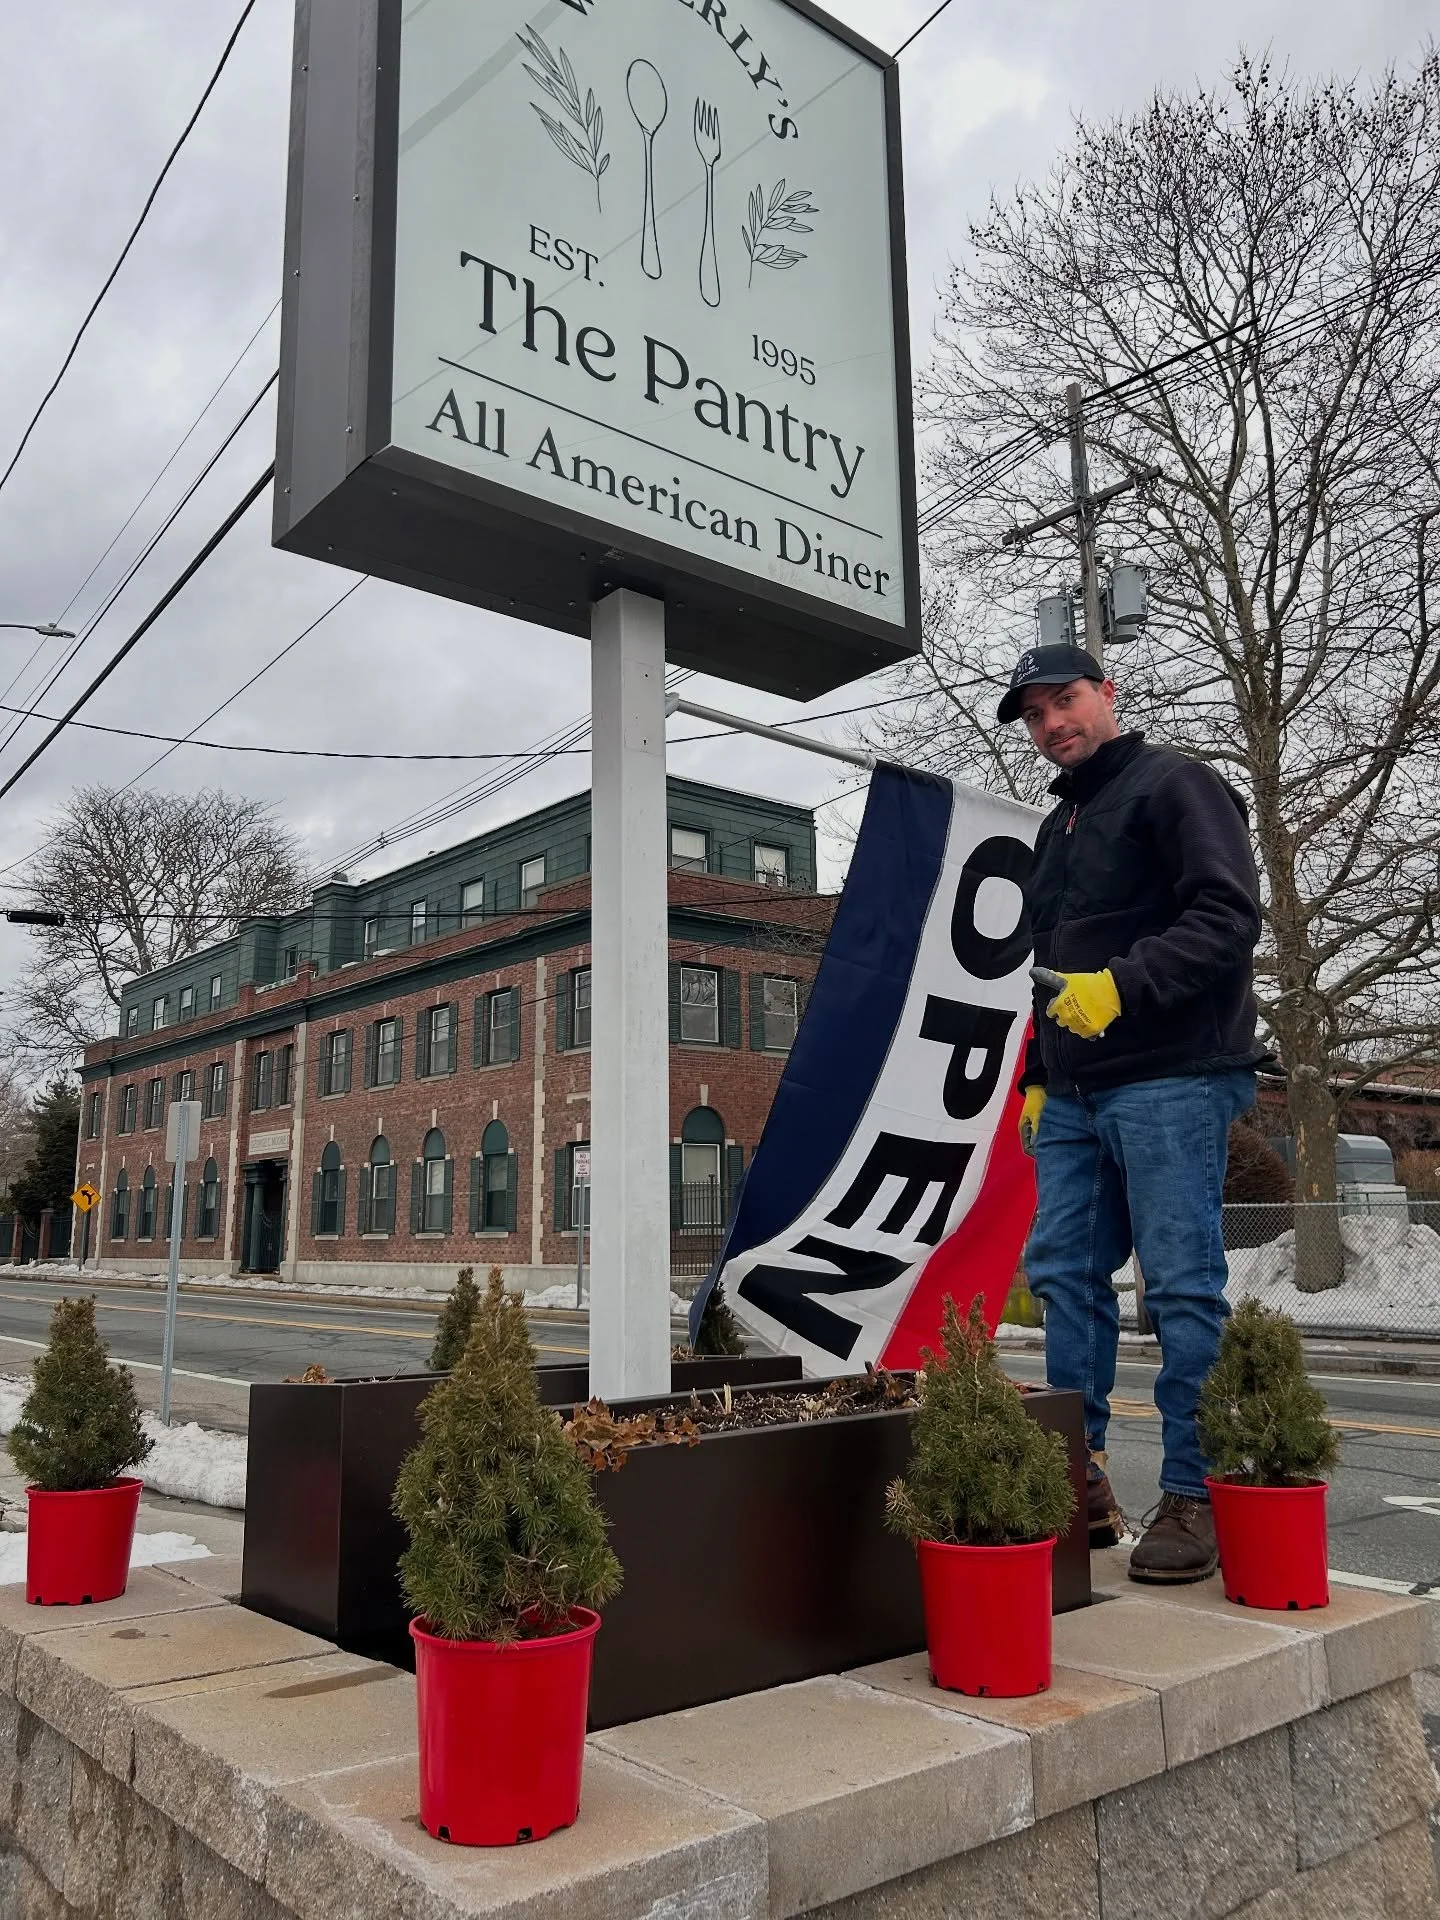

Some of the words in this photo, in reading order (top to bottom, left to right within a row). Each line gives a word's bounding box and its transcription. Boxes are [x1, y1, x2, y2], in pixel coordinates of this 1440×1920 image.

[529, 223, 605, 287] EST.
[460, 250, 617, 382] The
[643, 334, 866, 499] Pantry
[752, 334, 816, 386] 1995
[424, 388, 510, 458] All
[525, 427, 762, 552] American
[774, 517, 890, 597] Diner
[737, 835, 1036, 1362] OPEN
